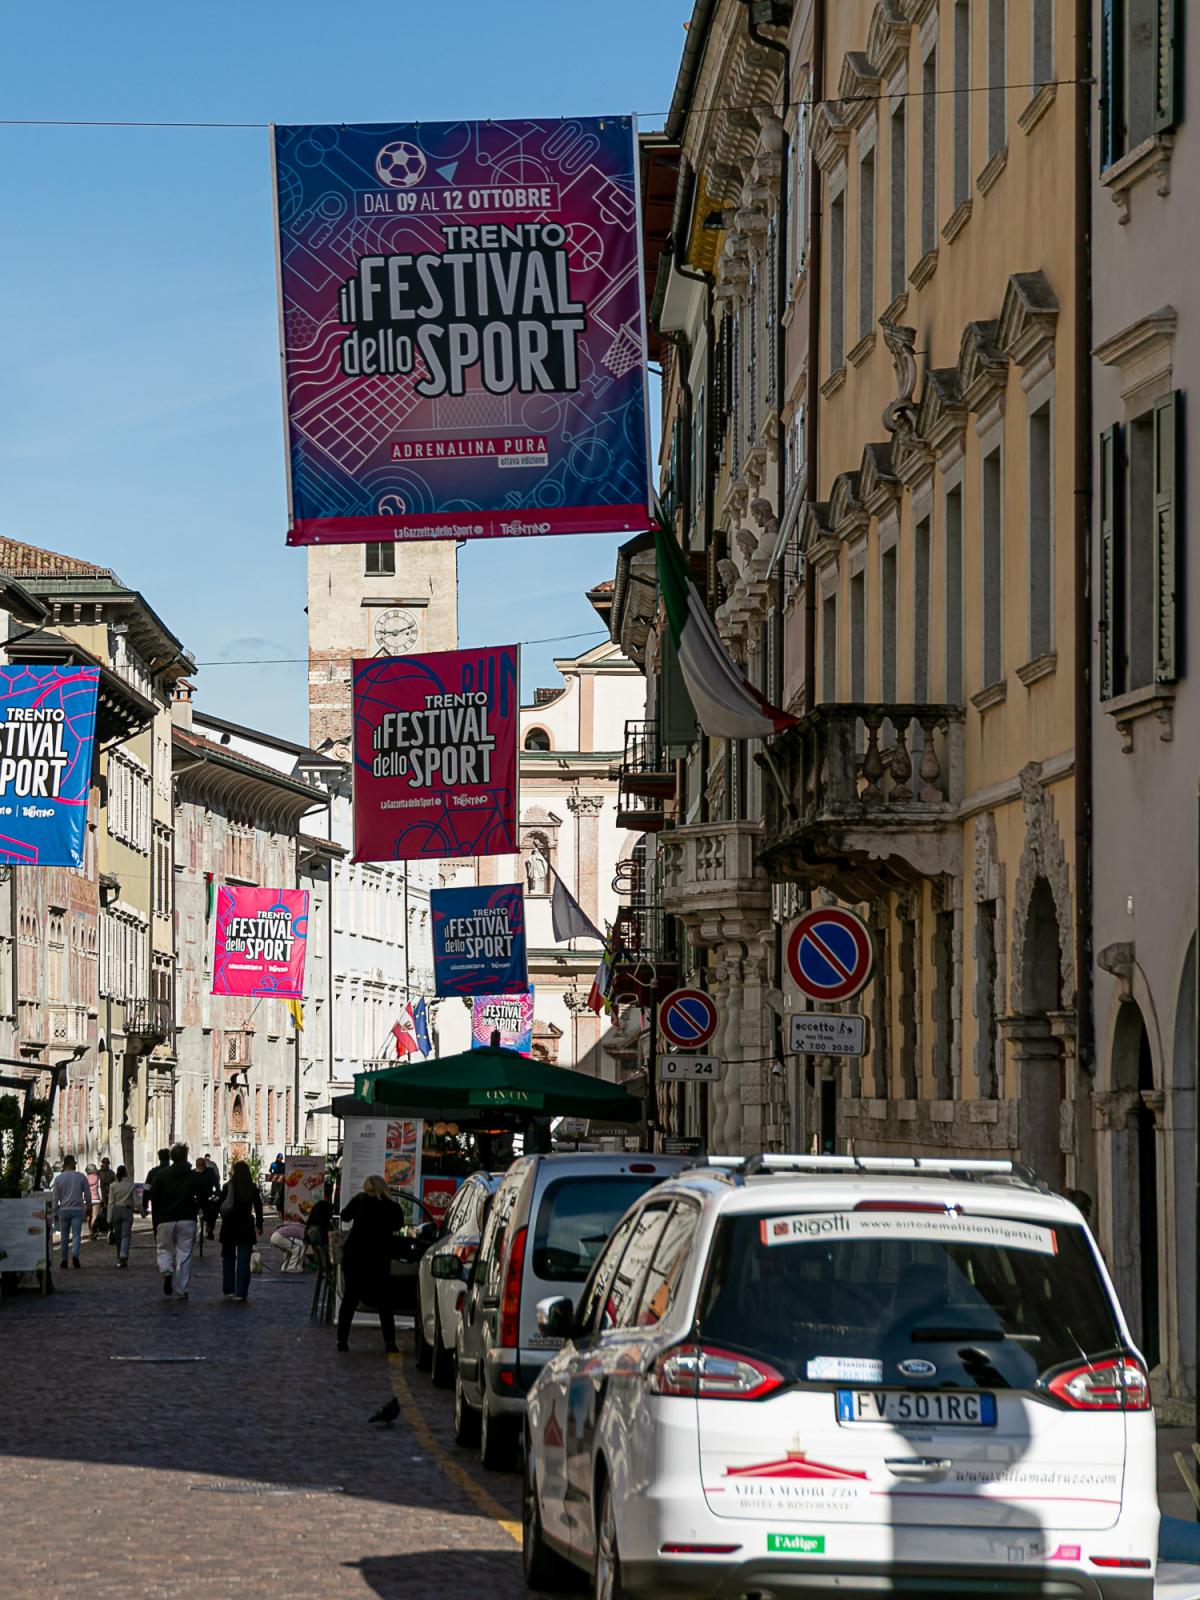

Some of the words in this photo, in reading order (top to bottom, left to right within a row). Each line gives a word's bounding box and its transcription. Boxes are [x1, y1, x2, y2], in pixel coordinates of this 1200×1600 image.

[363, 193, 394, 214] DAL
[397, 191, 417, 212] 09
[421, 190, 439, 211] AL
[443, 190, 463, 210] 12
[468, 187, 551, 209] OTTOBRE
[442, 224, 566, 249] TRENTO
[341, 280, 357, 324] il
[362, 251, 584, 321] FESTIVAL
[343, 328, 412, 375] dello
[416, 320, 585, 395] SPORT
[393, 440, 496, 458] ADRENALINA
[504, 438, 547, 453] PURA
[453, 525, 474, 538] Sport
[500, 520, 551, 536] TRENTINO
[425, 691, 487, 709] TRENTO
[6, 707, 65, 721] TRENTO
[373, 726, 381, 749] il
[383, 706, 495, 749] FESTIVAL
[373, 753, 407, 777] dello
[408, 743, 495, 787] SPORT
[257, 911, 292, 920] TRENTO
[473, 908, 508, 916] TRENTO
[232, 917, 295, 940] FESTIVAL
[449, 916, 513, 937] FESTIVAL
[226, 938, 246, 952] dello
[245, 938, 295, 962] SPORT
[445, 940, 465, 953] dello
[466, 936, 513, 958] SPORT
[486, 1005, 523, 1019] FESTIVAL
[495, 1018, 522, 1032] SPORT
[795, 1022, 835, 1032] eccetto
[667, 1062, 677, 1073] 0
[695, 1063, 713, 1074] 24
[792, 1215, 850, 1235] Rigotti
[857, 1393, 887, 1416] FV
[898, 1394, 979, 1420] 501RG
[774, 1535, 818, 1551] l'Adige
